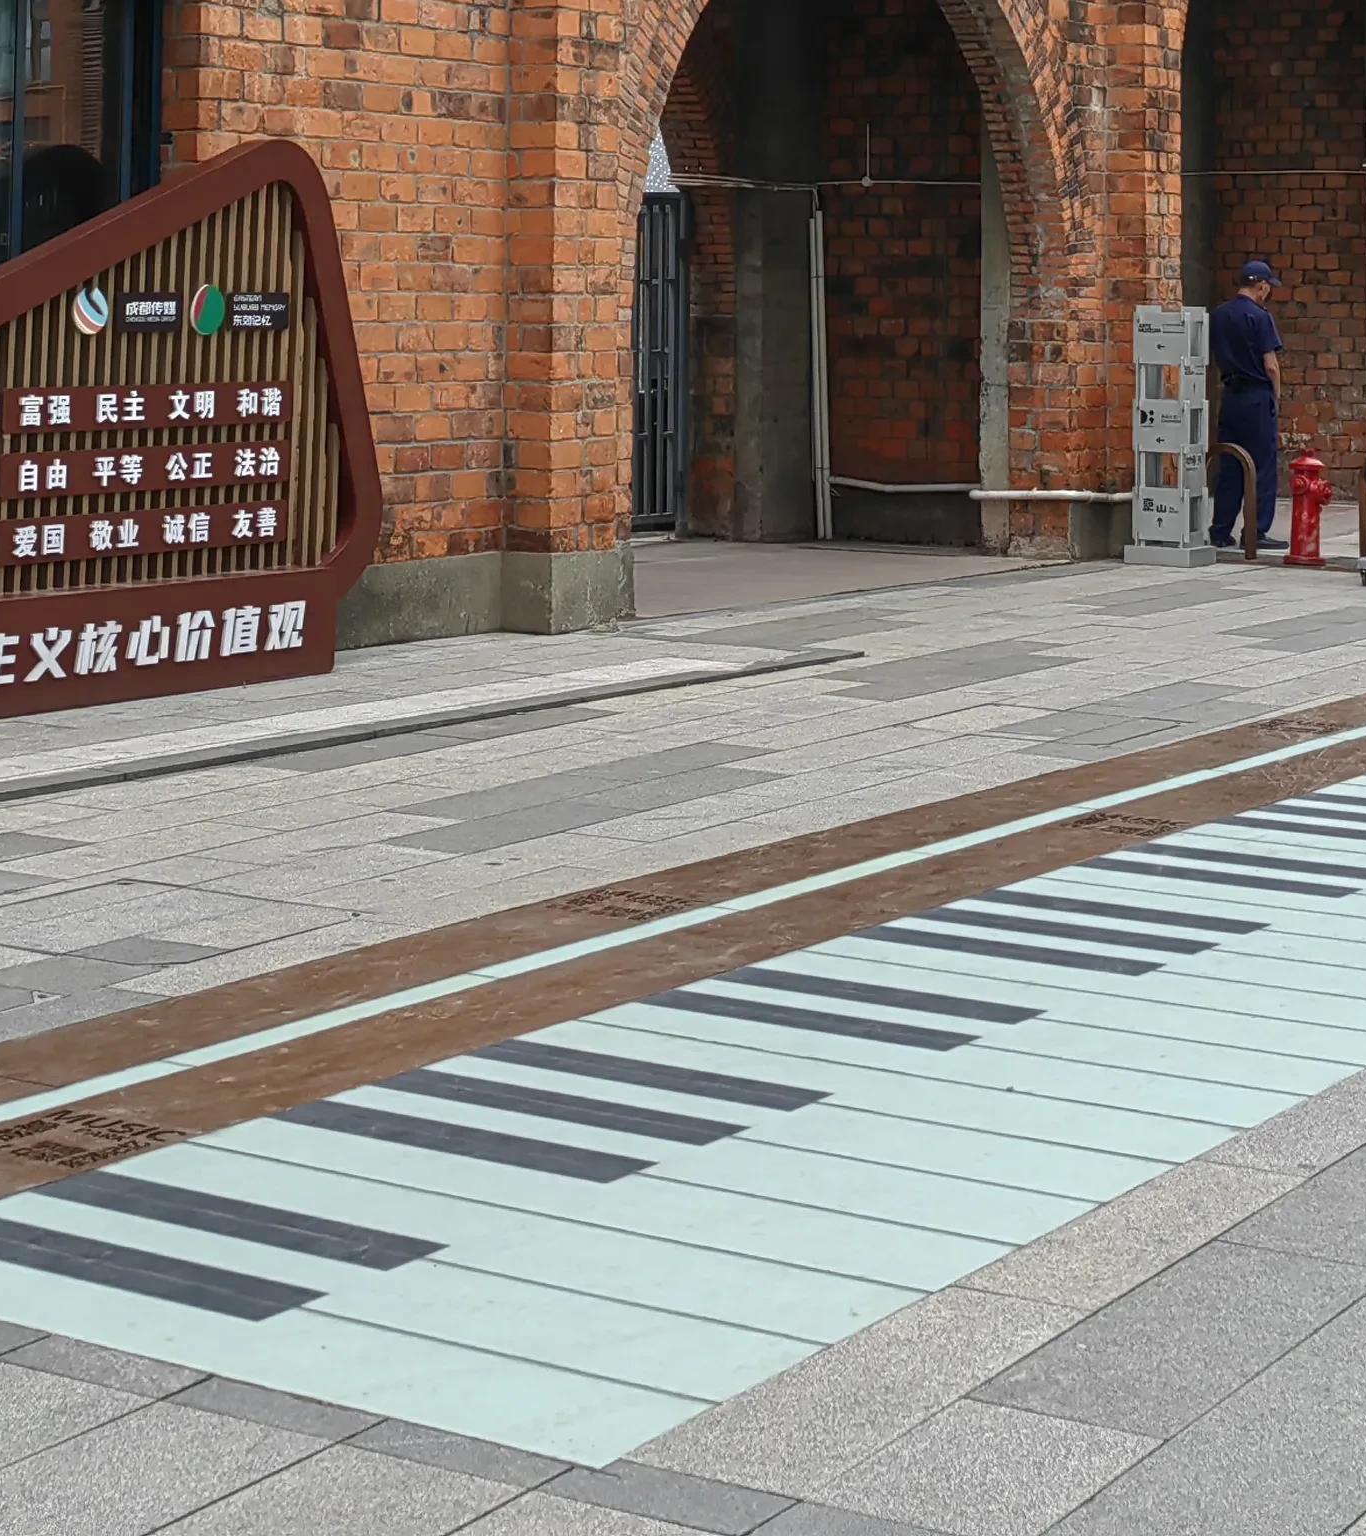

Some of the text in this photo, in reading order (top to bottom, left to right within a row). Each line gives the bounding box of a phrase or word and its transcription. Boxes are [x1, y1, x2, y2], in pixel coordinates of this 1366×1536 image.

[18, 387, 283, 427] 富强 民主 文明 和谐
[18, 446, 281, 492] 自由 平等 公正 法治
[12, 507, 278, 559] 爱国 敬业 诚信 友善
[45, 1109, 187, 1143] MUSIC
